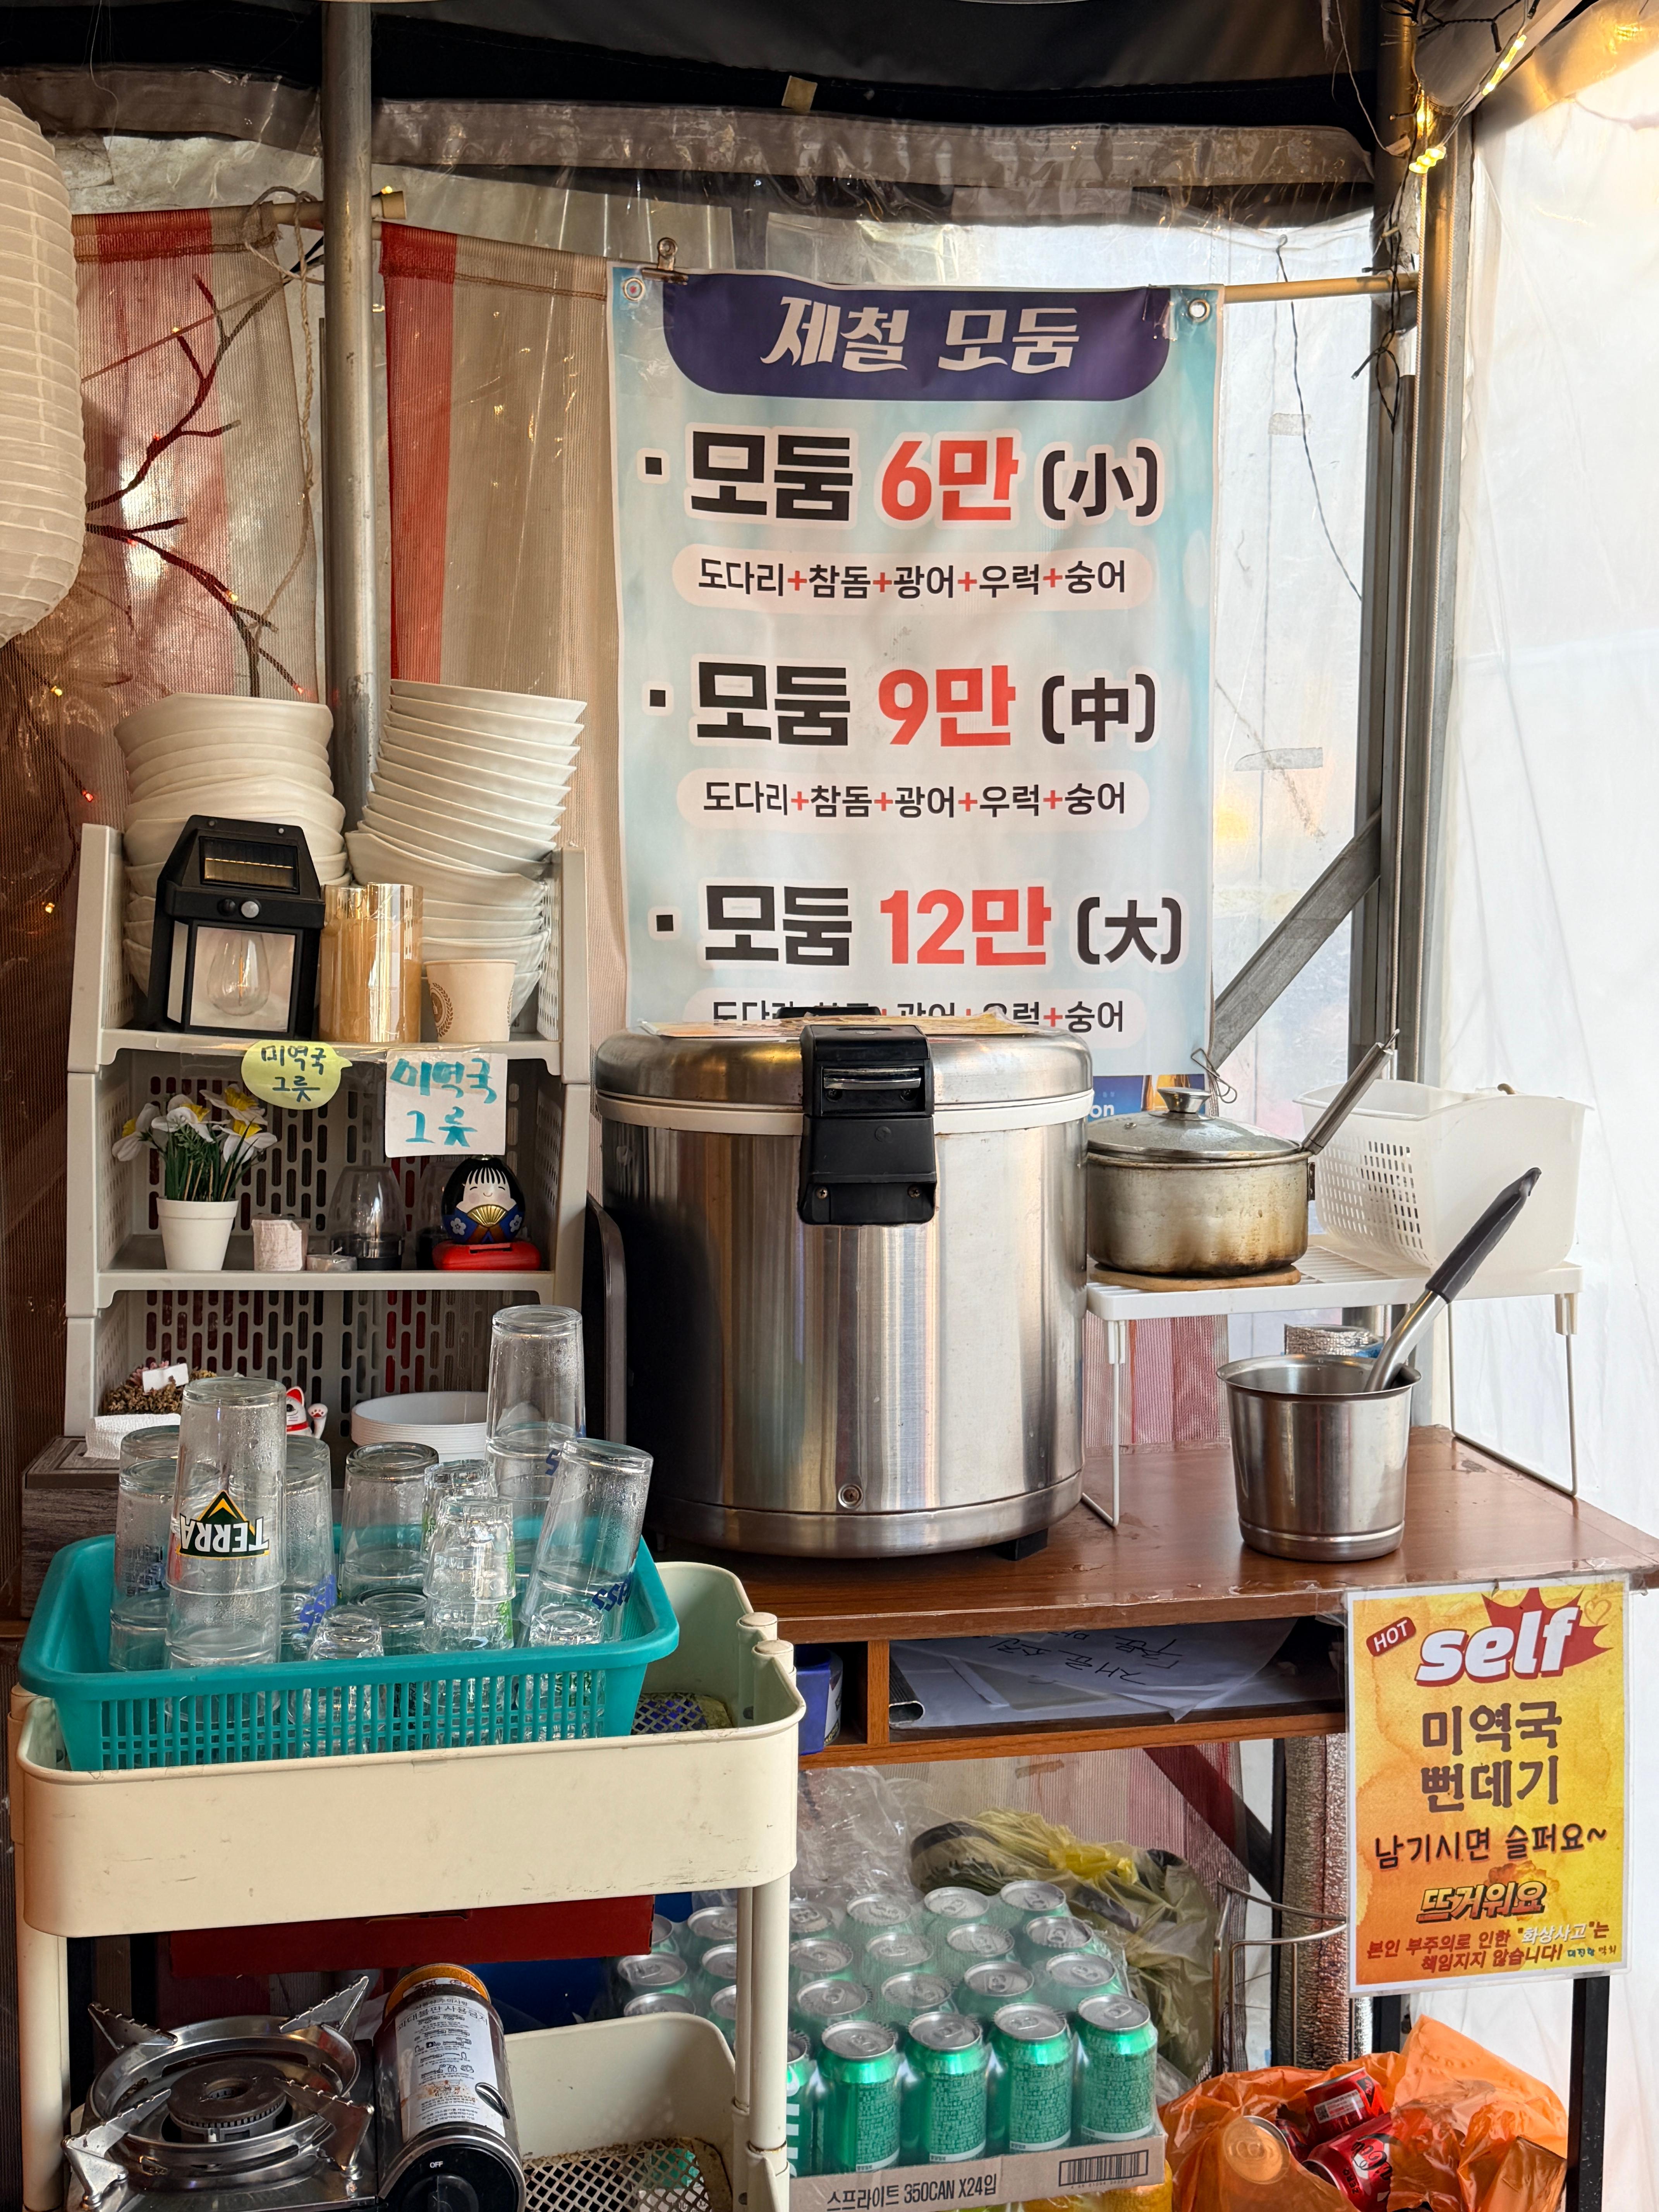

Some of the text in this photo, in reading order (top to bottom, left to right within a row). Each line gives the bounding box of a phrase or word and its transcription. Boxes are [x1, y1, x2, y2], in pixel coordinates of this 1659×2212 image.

[760, 295, 1079, 373] 제철 모둠
[690, 431, 853, 521] 모둠
[881, 436, 1018, 521] 6만
[697, 662, 850, 745] 모둠
[878, 665, 1015, 747] 9만
[705, 886, 852, 965] 모둠
[880, 887, 1051, 965] 12만
[261, 1045, 326, 1075] 미역국
[390, 1058, 497, 1103] 미역국
[273, 1076, 320, 1102] 그릇
[1089, 1105, 1114, 1118] on
[180, 1513, 269, 1553] TERRA
[1373, 1620, 1409, 1652] HOT
[1416, 1607, 1580, 1685] self
[1422, 1701, 1562, 1756] 미역국
[1421, 1755, 1558, 1813] 뻔데기
[1376, 1823, 1606, 1869] 남기시면 슬퍼요~
[1367, 1939, 1400, 1959] 본인
[1406, 1934, 1470, 1955] 부주의로
[1479, 1929, 1511, 1949] 인한
[1421, 1951, 1486, 1973] 책임지지
[827, 2174, 996, 2211] 스프라이트 350CAN X24입
[1343, 2168, 1359, 2194] ZERO
